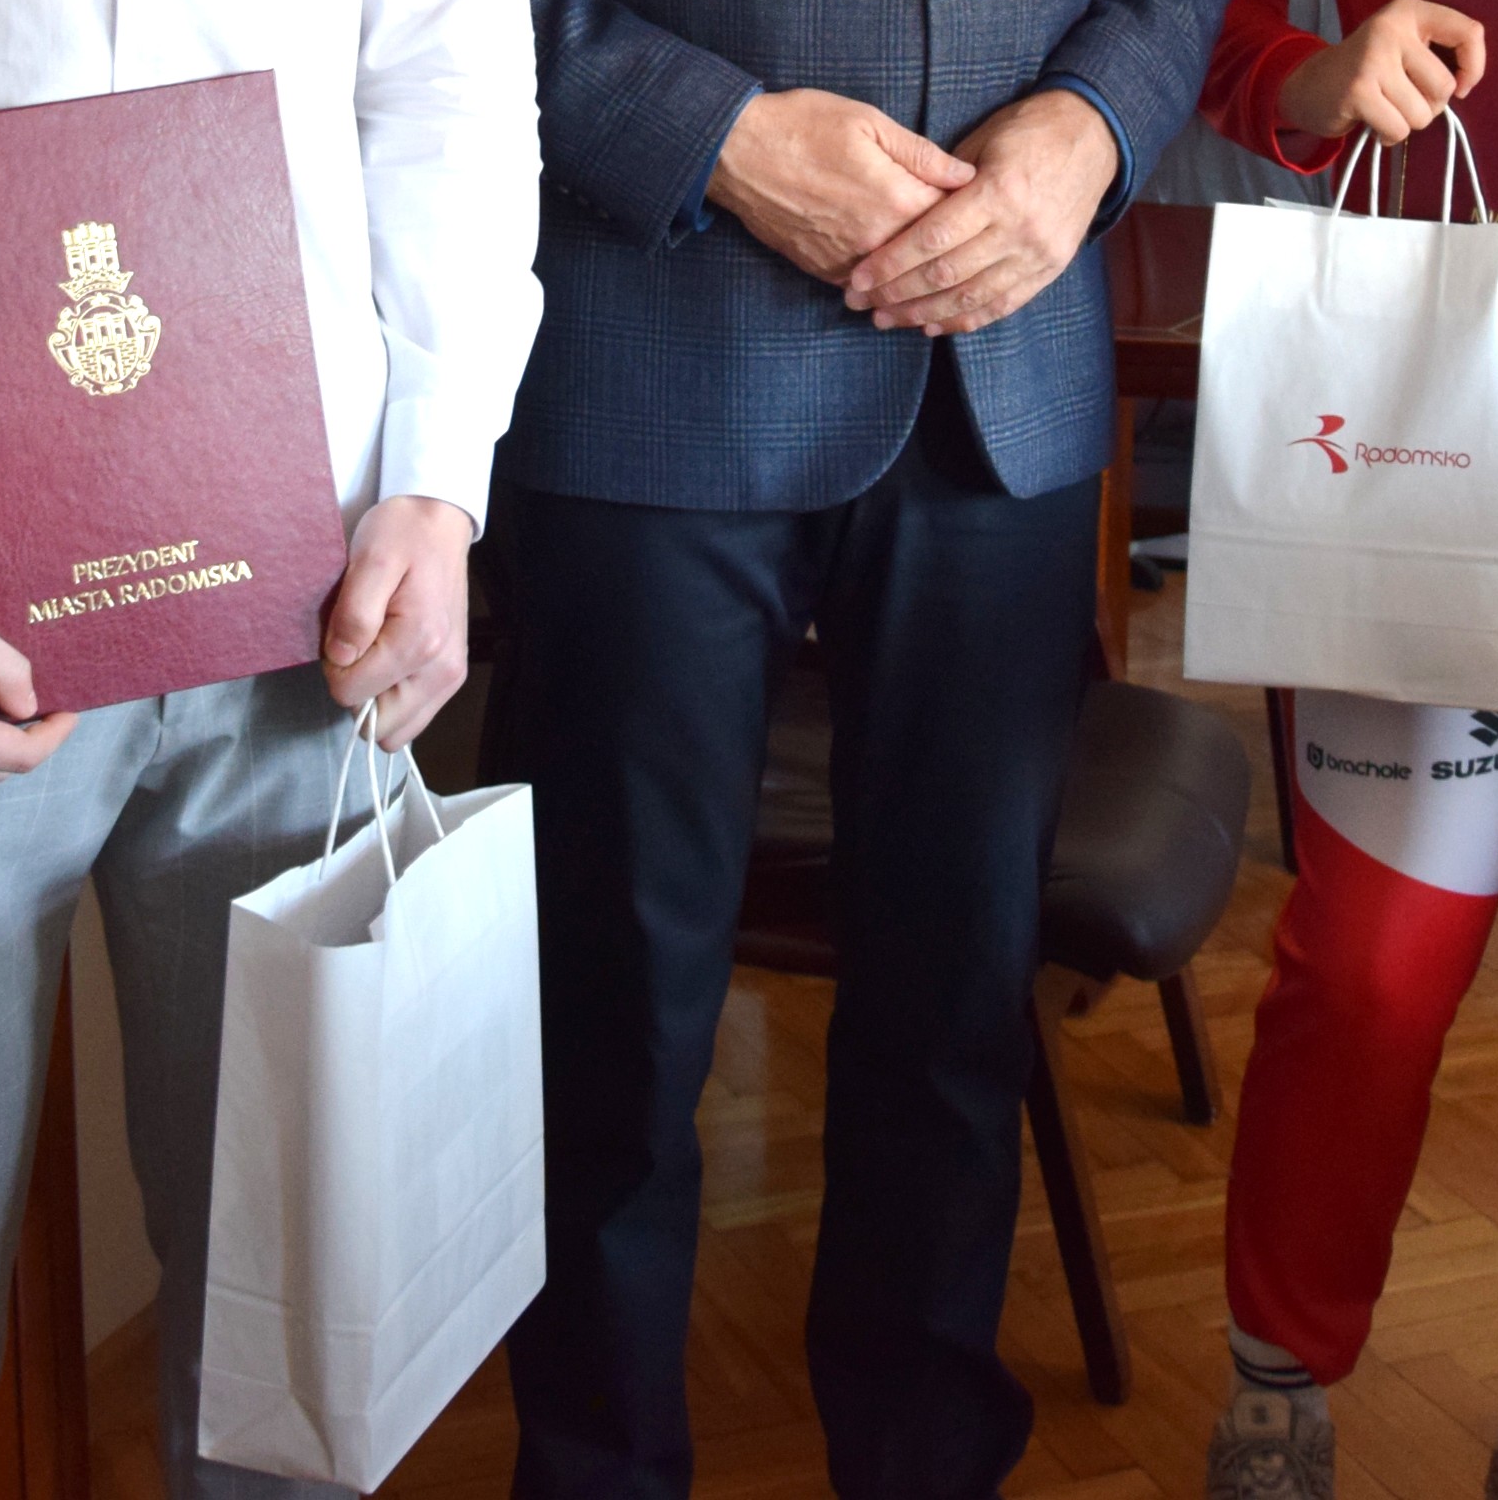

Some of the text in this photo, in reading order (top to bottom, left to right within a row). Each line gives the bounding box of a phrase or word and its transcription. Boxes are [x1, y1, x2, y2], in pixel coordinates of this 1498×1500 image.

[1354, 442, 1471, 469] Radomsko
[72, 539, 199, 585] PREZYDENT
[28, 560, 253, 624] MIASTA RADOMSKA
[1326, 752, 1412, 780] brachole
